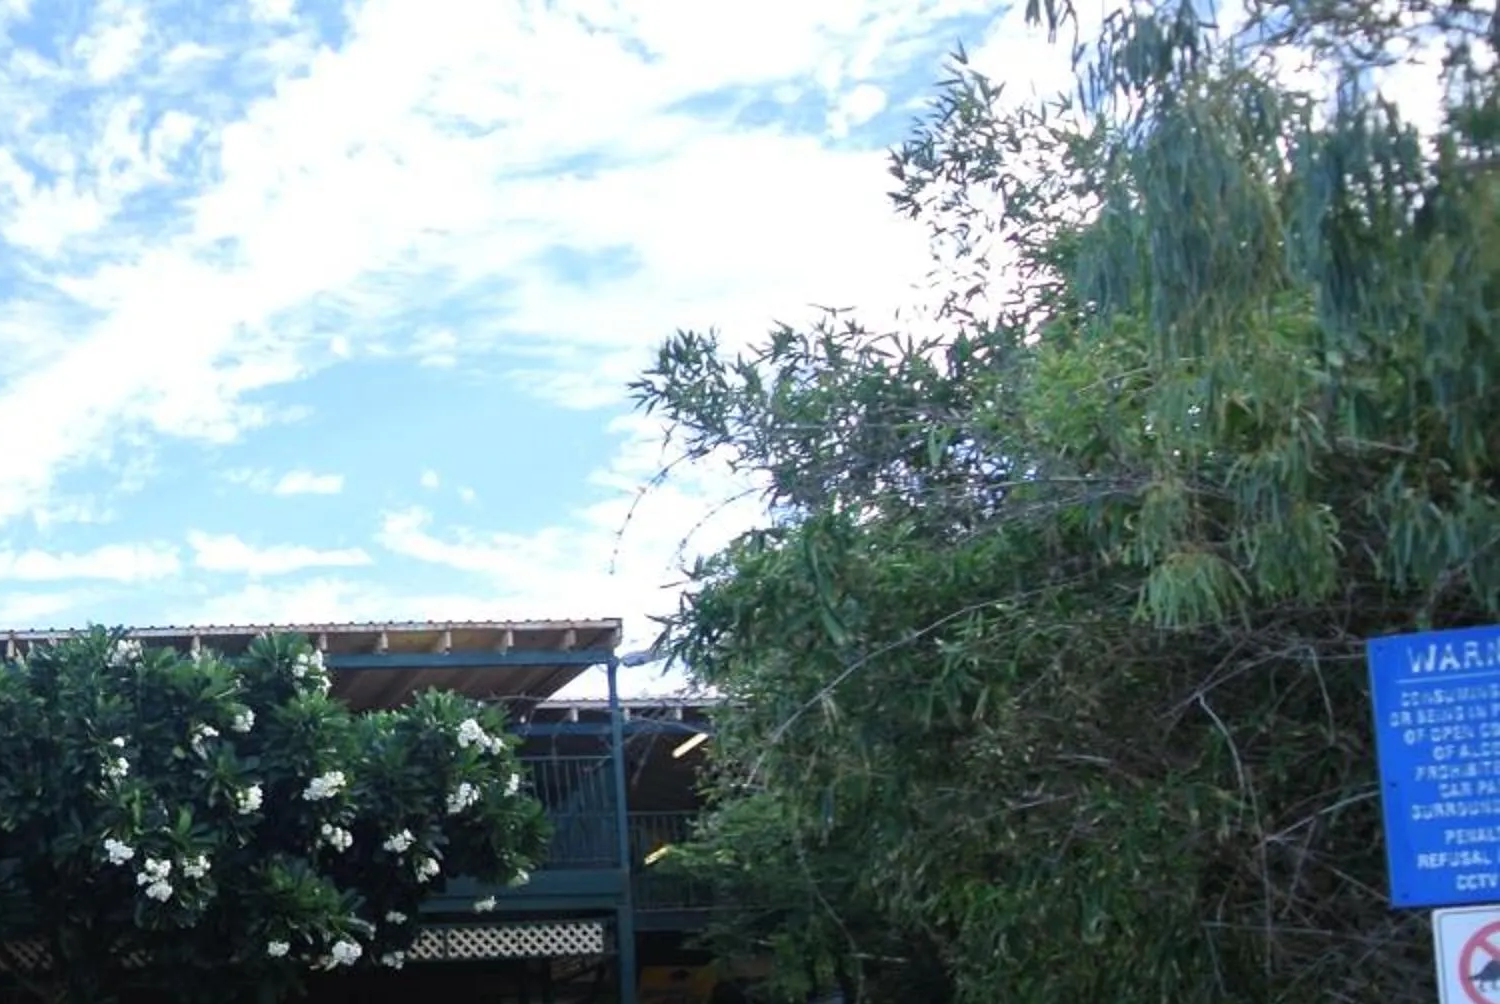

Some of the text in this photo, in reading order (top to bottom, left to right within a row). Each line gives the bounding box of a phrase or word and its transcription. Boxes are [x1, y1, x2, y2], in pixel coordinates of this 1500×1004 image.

[1403, 728, 1425, 745] OF
[1433, 744, 1455, 761] OF
[1456, 873, 1498, 890] CCTV
